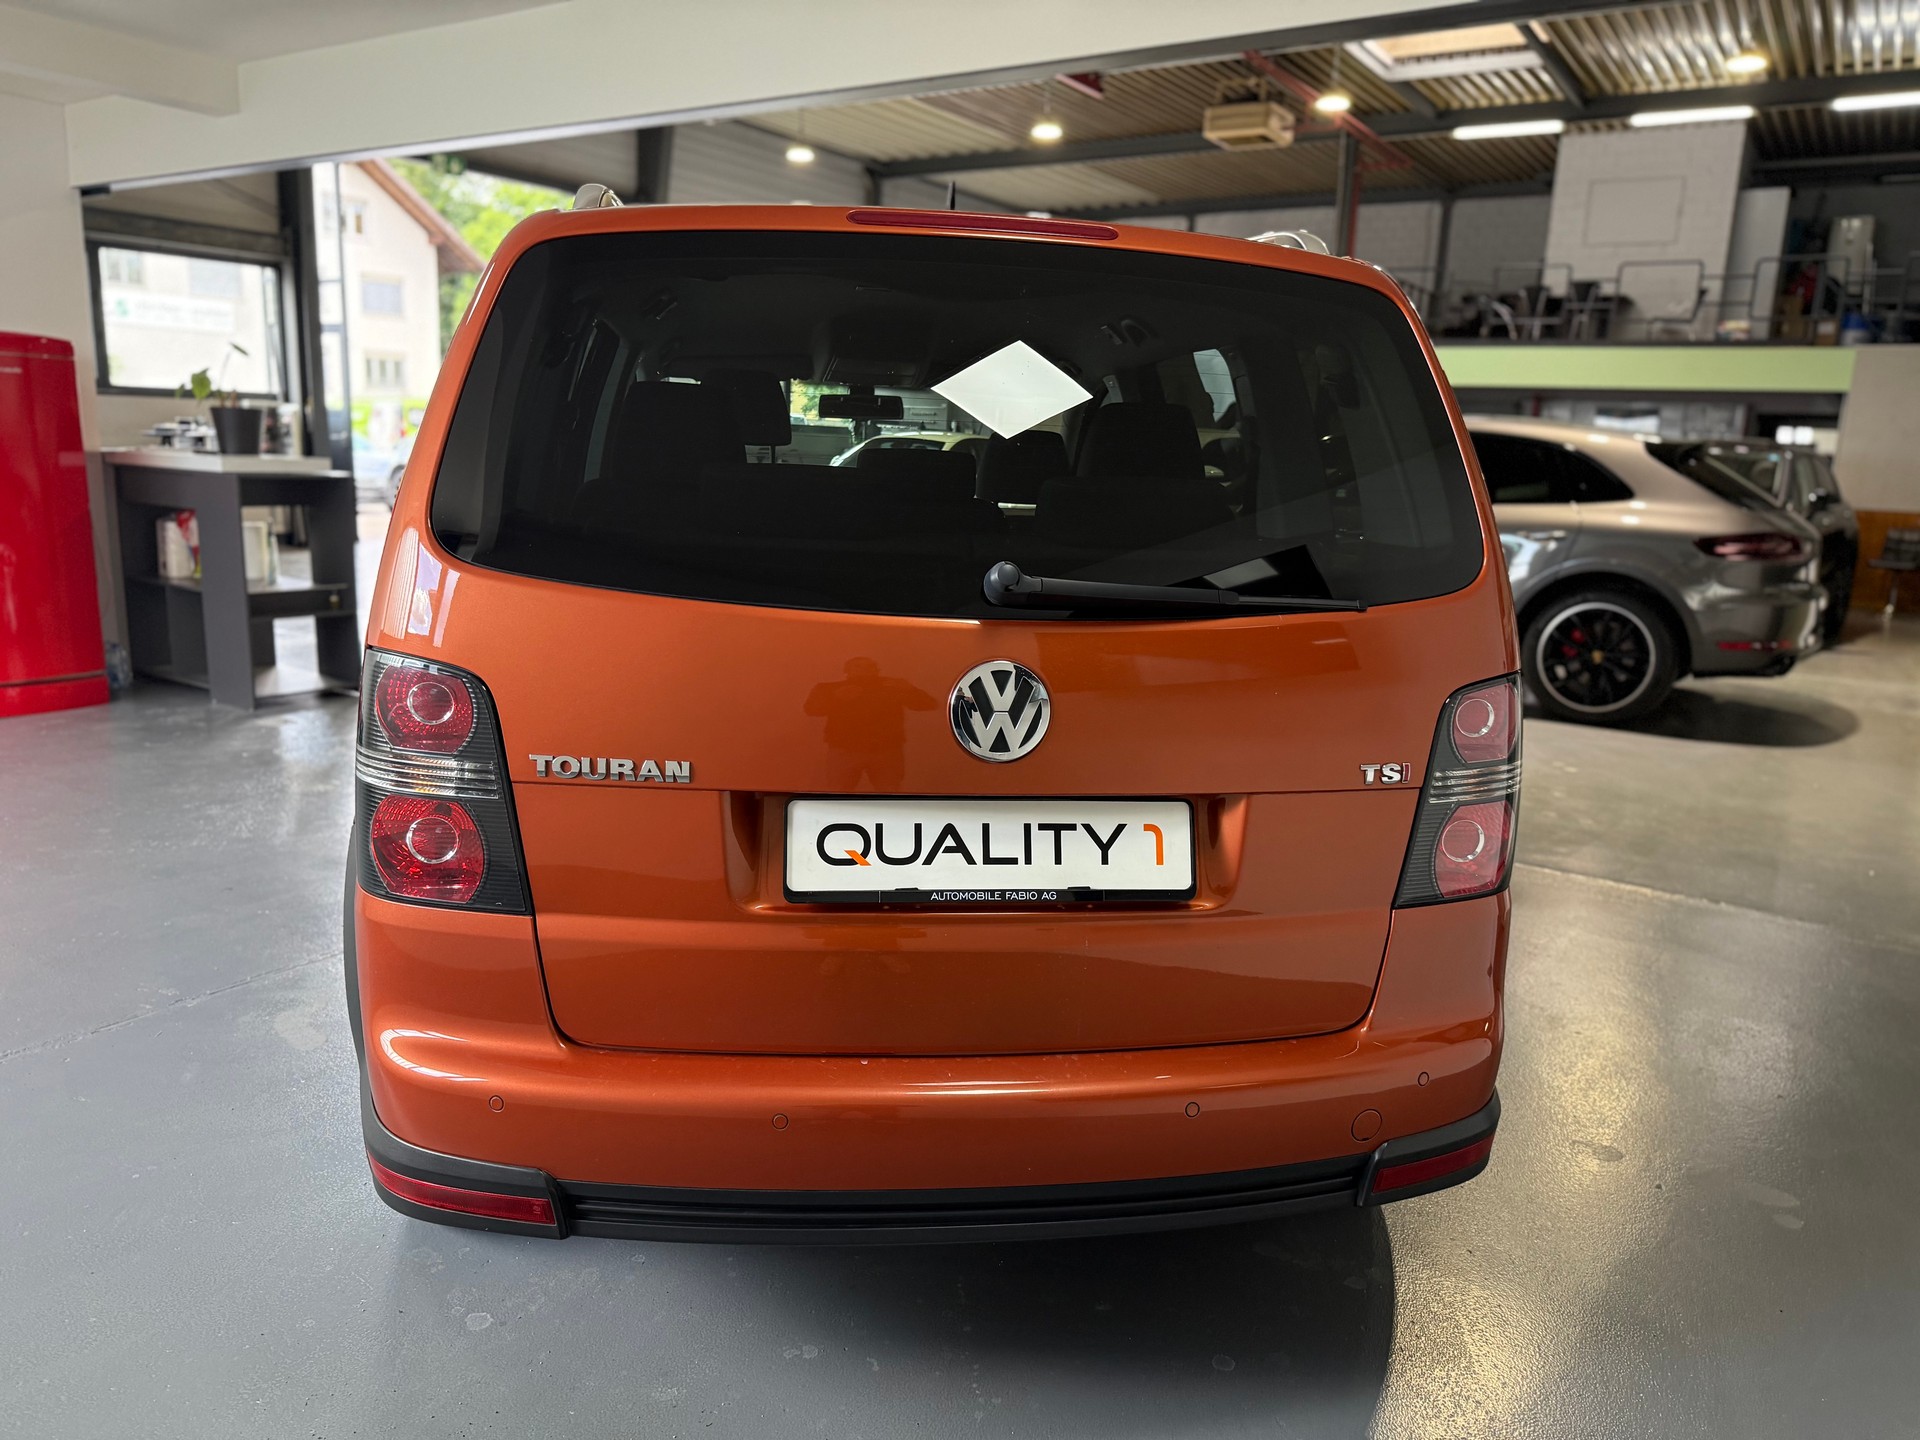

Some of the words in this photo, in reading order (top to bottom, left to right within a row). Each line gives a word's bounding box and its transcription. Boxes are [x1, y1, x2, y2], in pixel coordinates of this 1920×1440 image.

[529, 754, 691, 783] TOURAN
[1360, 763, 1411, 785] TSI
[816, 823, 1127, 866] QUALITY
[1143, 823, 1164, 866] 1
[930, 891, 1001, 900] AUTOMOBILE
[1005, 891, 1038, 900] FABIO
[1041, 891, 1057, 900] AG
